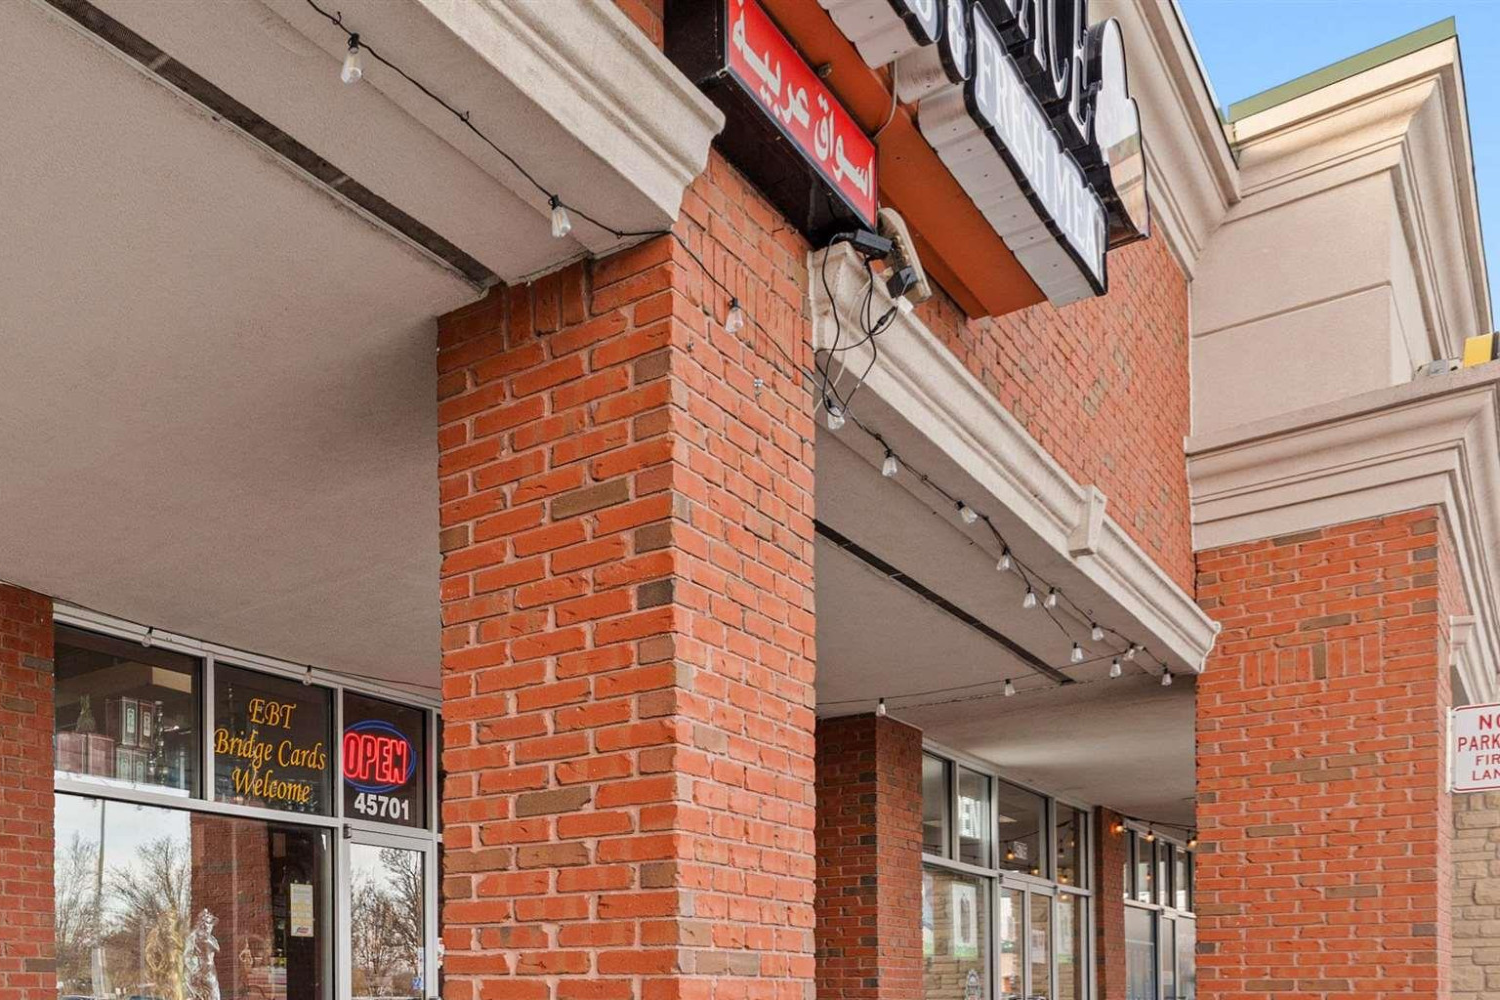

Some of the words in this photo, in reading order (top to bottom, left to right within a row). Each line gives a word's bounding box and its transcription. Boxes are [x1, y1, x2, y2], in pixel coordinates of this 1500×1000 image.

[977, 22, 1048, 201] FRESH
[249, 698, 297, 729] EBT
[1479, 713, 1500, 730] N
[214, 727, 274, 770] Bridge
[277, 740, 326, 771] Cards
[343, 732, 408, 784] OPEN
[231, 765, 312, 803] Welcome
[354, 792, 409, 820] 45701
